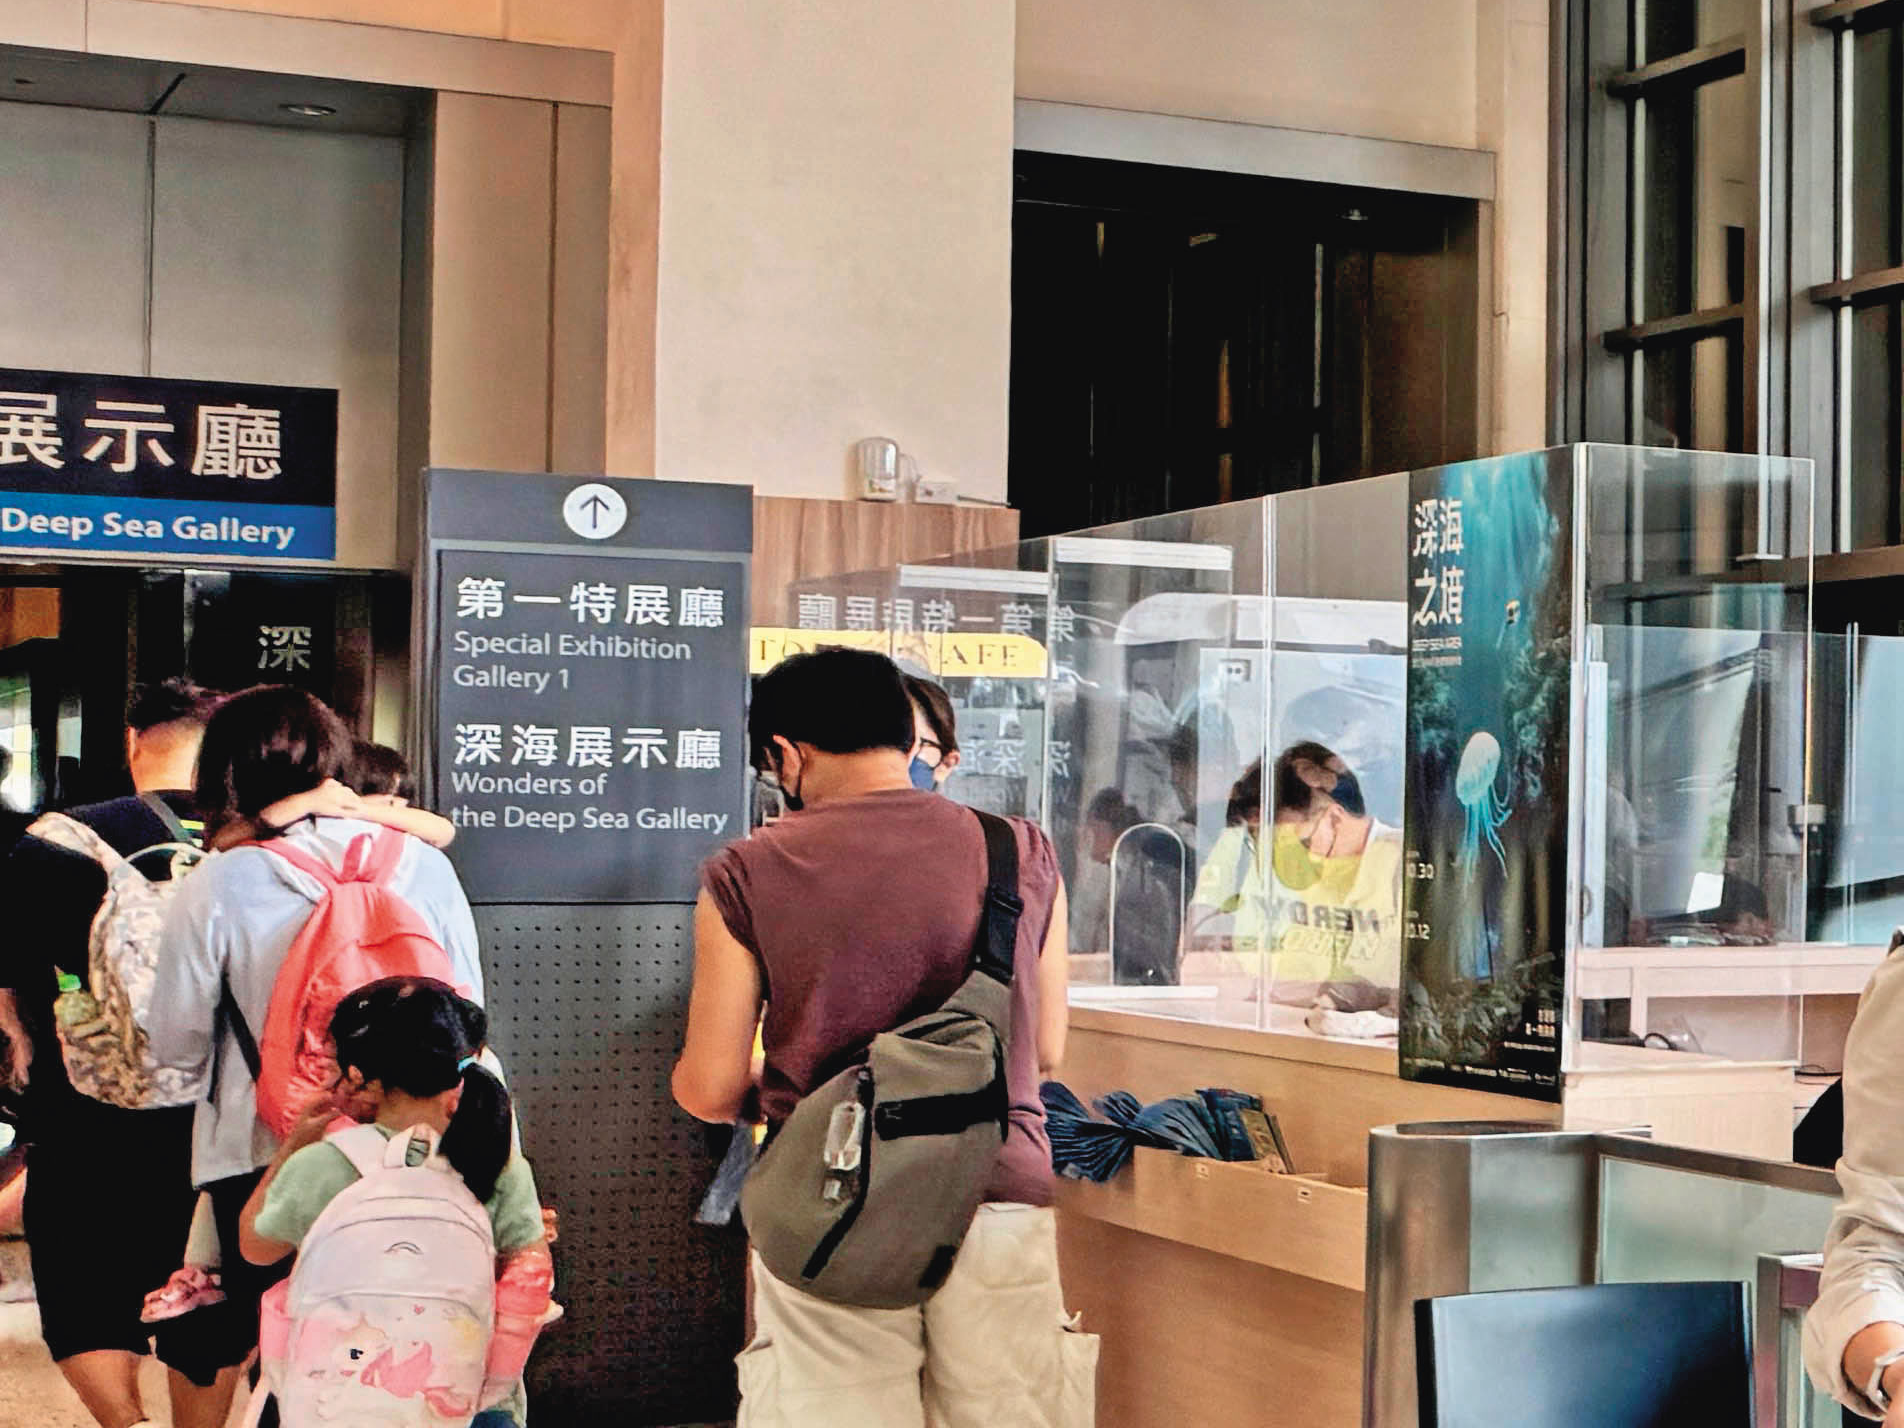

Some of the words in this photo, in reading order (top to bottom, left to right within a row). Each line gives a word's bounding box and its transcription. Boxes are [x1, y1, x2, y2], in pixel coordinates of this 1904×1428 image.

[0, 391, 282, 480] 展示廳
[1, 508, 93, 540] Deep
[103, 512, 164, 539] Sea
[172, 516, 295, 550] Gallery
[456, 576, 724, 628] 第一特展廳
[258, 625, 312, 672] 深
[454, 631, 550, 657] Special
[558, 634, 691, 660] Exhibition
[453, 664, 550, 694] Gallery
[559, 669, 569, 689] 1
[454, 723, 721, 769] 深海展示廳
[451, 772, 572, 795] Wonders
[578, 773, 608, 795] of
[451, 805, 496, 828] the
[504, 806, 574, 833] Deep
[583, 808, 629, 829] Sea
[637, 808, 728, 835] Gallery
